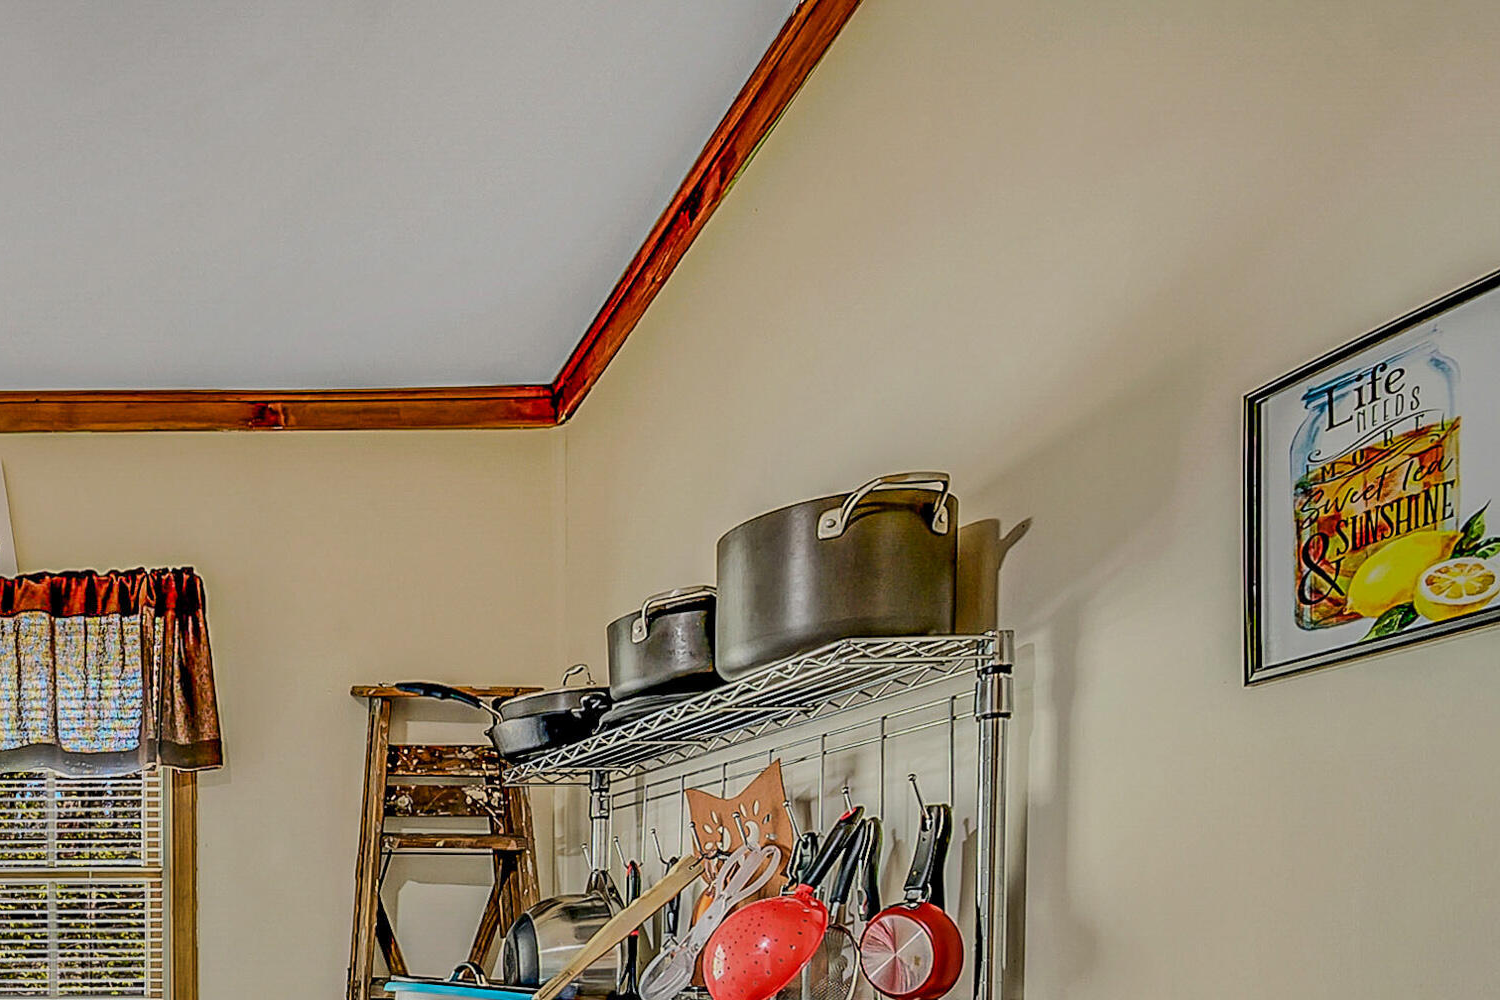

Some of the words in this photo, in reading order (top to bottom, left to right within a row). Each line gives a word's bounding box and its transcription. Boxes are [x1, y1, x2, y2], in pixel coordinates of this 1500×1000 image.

[1324, 362, 1406, 432] Life
[1356, 386, 1421, 434] NEEDS
[1320, 414, 1426, 484] MORE
[1299, 463, 1392, 530] Sweet
[1396, 450, 1455, 491] Tea
[1299, 532, 1346, 606] &
[1336, 479, 1456, 556] SUNSHINE
